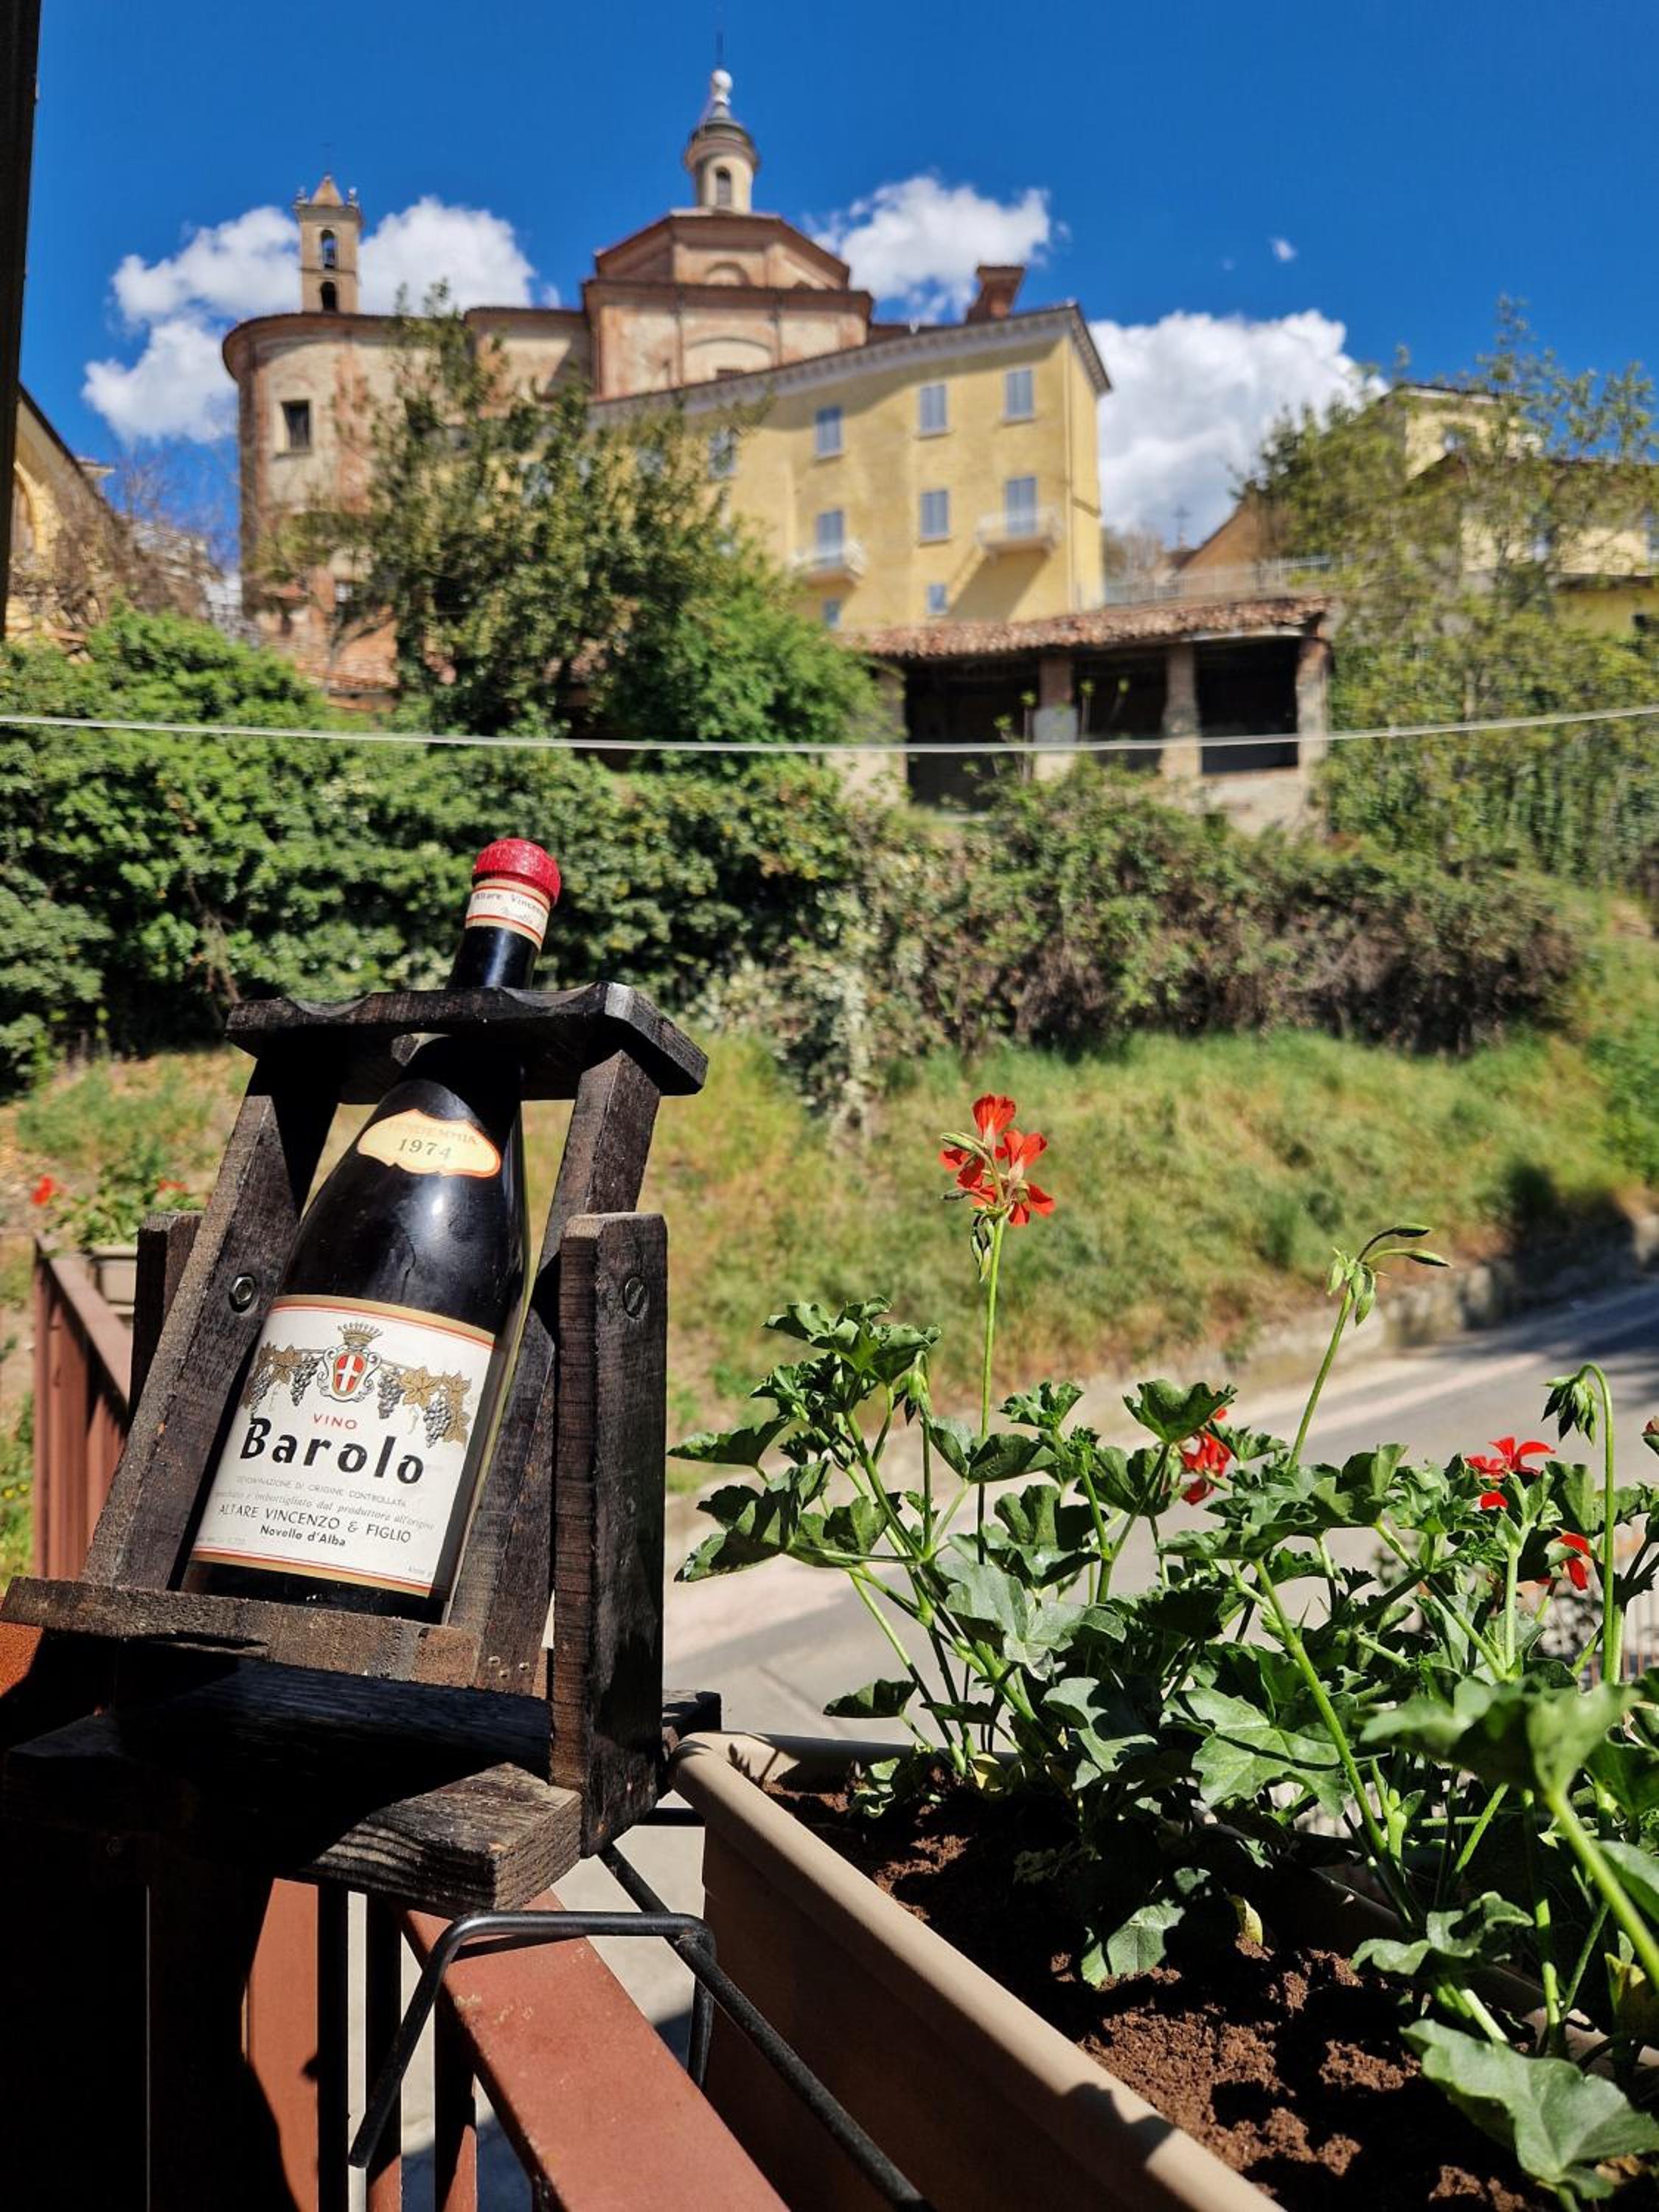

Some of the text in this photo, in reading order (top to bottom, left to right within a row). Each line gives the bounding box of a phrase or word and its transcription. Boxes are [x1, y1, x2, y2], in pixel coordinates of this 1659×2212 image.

[397, 1138, 452, 1161] 1974
[311, 1413, 358, 1430] VINO
[240, 1416, 425, 1485] Barolo
[307, 1484, 344, 1496] ORIGINE
[316, 1500, 333, 1511] dal
[337, 1503, 390, 1521] produttore
[218, 1503, 412, 1543] ALTARE VINCENZO & FIGLIO
[260, 1524, 347, 1547] Novello d'Alba
